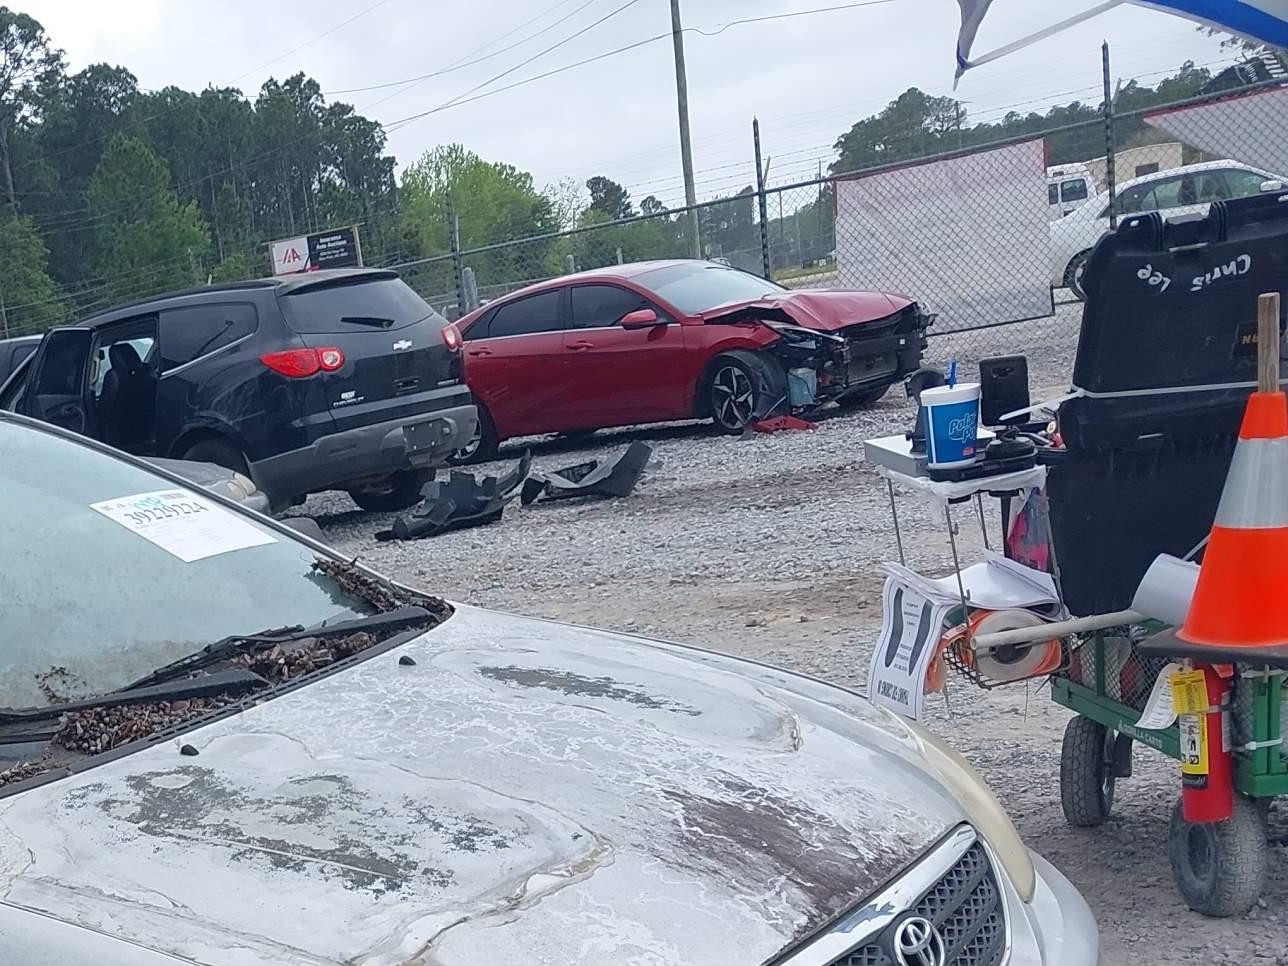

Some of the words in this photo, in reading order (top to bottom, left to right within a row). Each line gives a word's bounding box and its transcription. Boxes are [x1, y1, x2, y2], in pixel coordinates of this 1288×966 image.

[1136, 263, 1172, 293] Lee
[1190, 254, 1252, 292] Chris
[123, 501, 209, 525] 39229224
